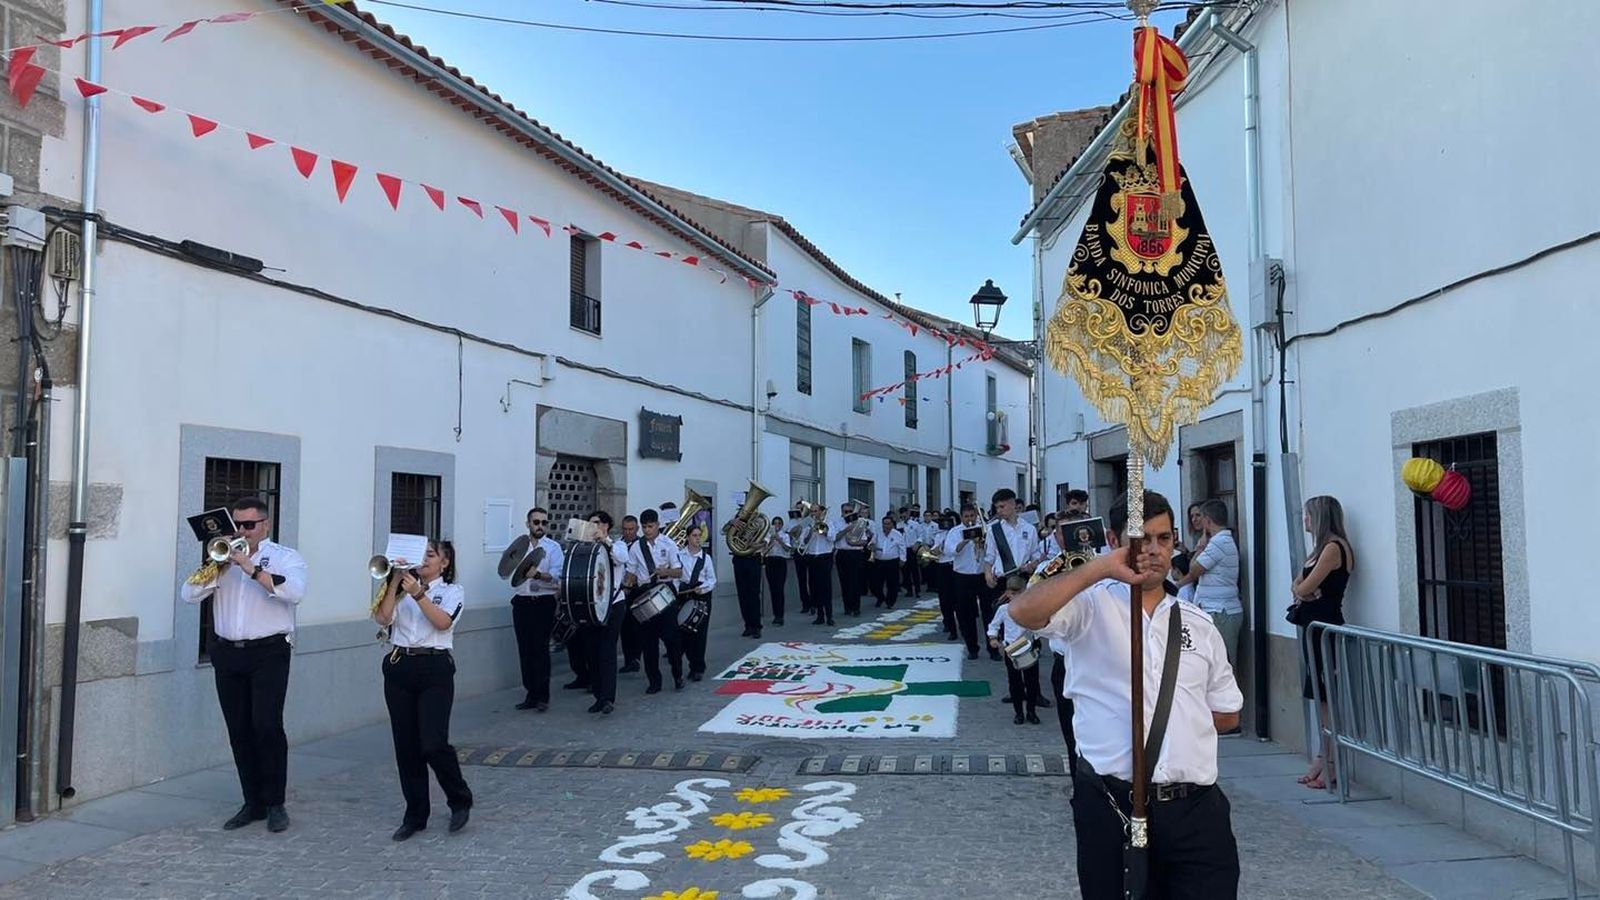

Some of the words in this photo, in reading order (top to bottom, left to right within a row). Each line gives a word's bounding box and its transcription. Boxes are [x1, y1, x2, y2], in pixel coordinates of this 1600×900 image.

[1085, 223, 1107, 267] BANDA
[1106, 268, 1170, 296] SINFONICA
[1109, 288, 1136, 310] DOS
[1143, 291, 1185, 314] TORRES
